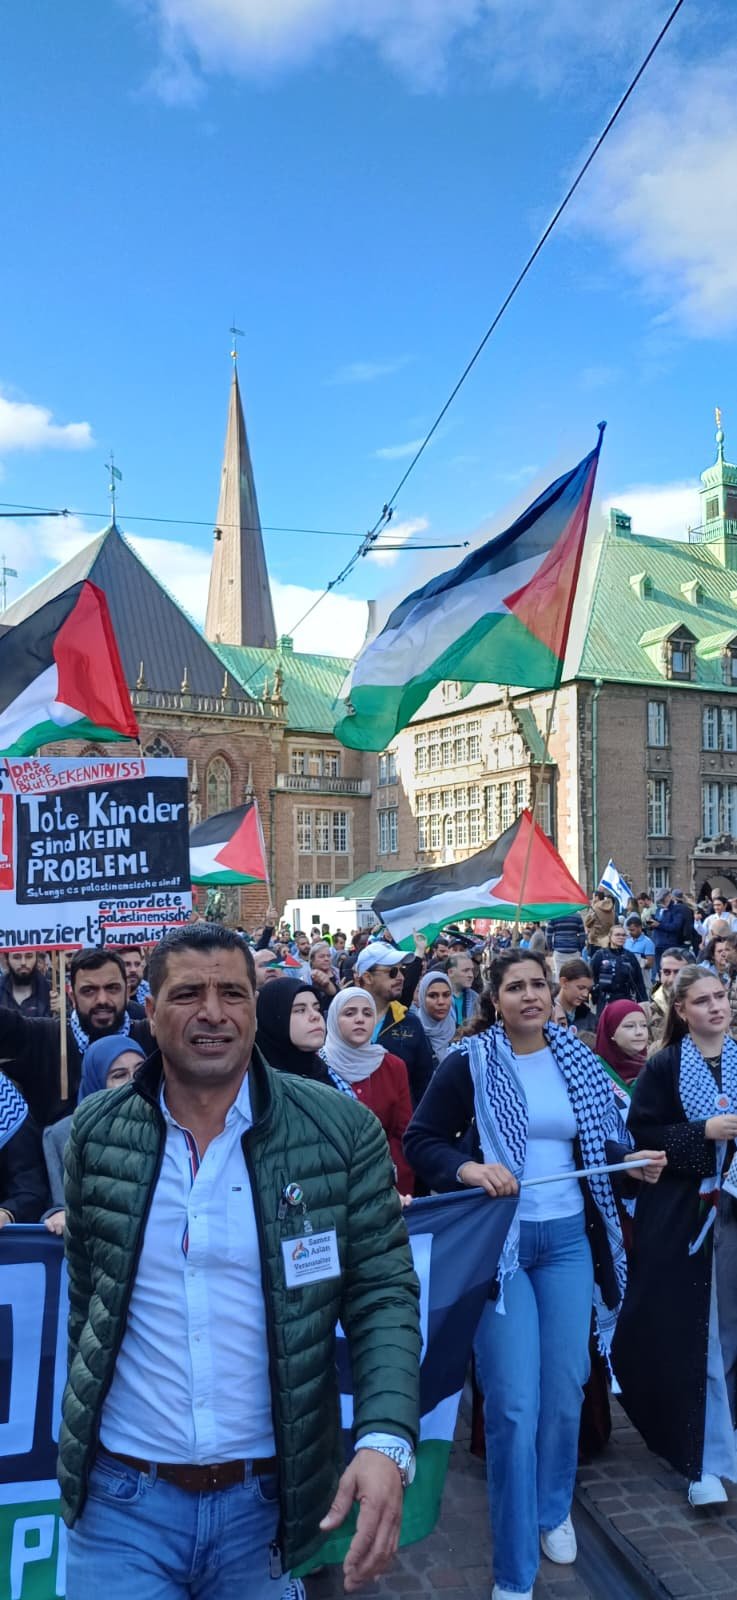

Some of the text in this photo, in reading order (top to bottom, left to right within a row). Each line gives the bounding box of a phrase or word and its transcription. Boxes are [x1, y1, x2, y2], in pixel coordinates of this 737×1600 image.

[11, 759, 40, 778] DAS
[16, 763, 52, 786] GROSSE
[20, 794, 80, 833] Tote
[88, 791, 185, 828] Kinder
[31, 828, 131, 857] sind KEIN
[27, 851, 149, 885] PROBLEM!
[98, 893, 182, 909] ermordete
